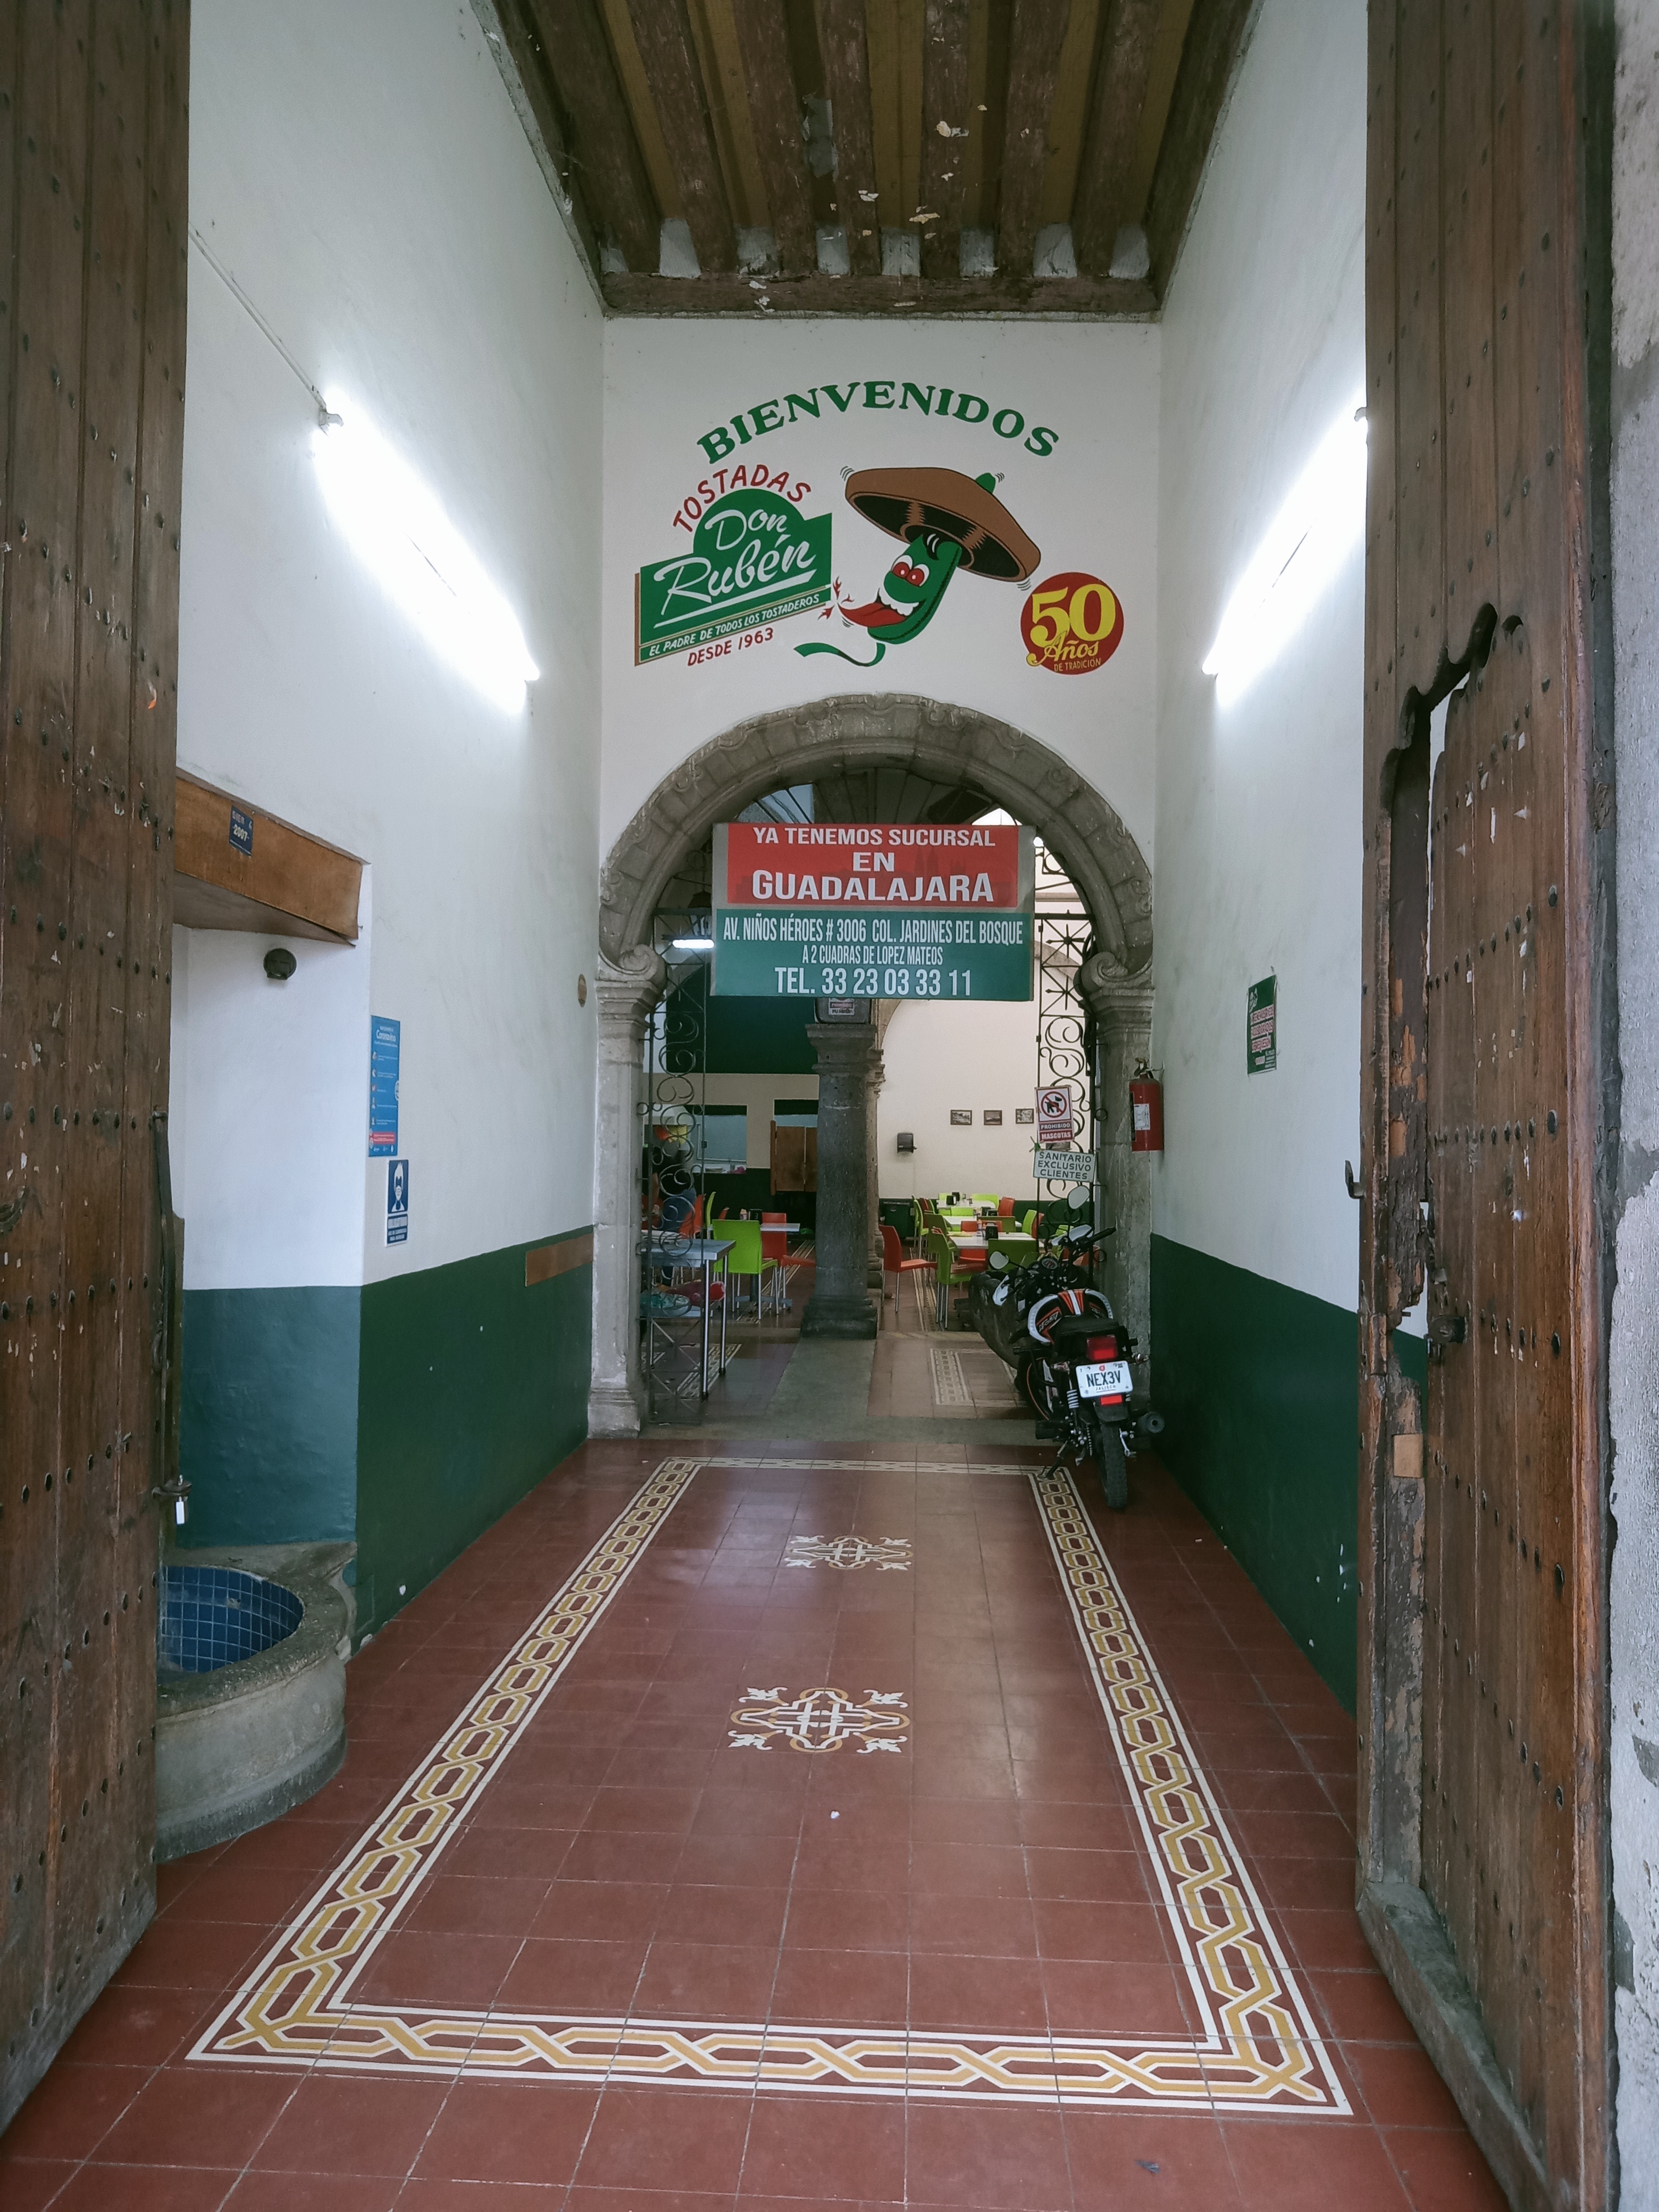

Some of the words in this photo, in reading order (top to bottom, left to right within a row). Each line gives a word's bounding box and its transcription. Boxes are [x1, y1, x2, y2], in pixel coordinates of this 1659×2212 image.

[697, 381, 1060, 464] BIENVENIDOS
[673, 464, 811, 533] TOSTADAS
[705, 508, 787, 551] Don
[654, 534, 817, 616] Rubén
[649, 646, 660, 657] EL
[663, 633, 696, 652] PADRE
[700, 629, 713, 641] DE
[715, 618, 743, 636] TODOS
[744, 613, 760, 626] LOS
[761, 593, 820, 621] TOSTADEROS
[1030, 583, 1116, 648] 50
[687, 640, 733, 667] DESDE
[738, 627, 774, 650] 1963
[1026, 630, 1100, 667] Años
[1053, 663, 1063, 672] DE
[752, 827, 778, 844] YA
[784, 827, 883, 846] TENEMOS
[888, 828, 996, 847] SUCURSAL
[852, 852, 895, 873] EN
[752, 869, 995, 902] GUADALAJARA
[723, 917, 740, 941] AV.
[743, 912, 777, 941] NIÑOS
[780, 913, 824, 942] HÉROES
[825, 918, 834, 942] #
[836, 918, 866, 942] 3006
[872, 919, 896, 943] COL.
[899, 919, 953, 944] JARDINES
[956, 920, 976, 944] DEL
[979, 920, 1023, 946] BOSQUE
[802, 944, 809, 963] A
[811, 944, 817, 963] 2
[819, 945, 861, 964] CUADRAS
[863, 945, 875, 965] DE
[877, 945, 905, 965] LOPEZ
[907, 946, 943, 966] MATEOS
[774, 967, 816, 994] TEL.
[822, 967, 847, 995] 33
[853, 968, 878, 995] 23
[884, 968, 910, 996] 03
[915, 968, 941, 996] 33
[948, 969, 971, 996] 11
[1037, 1160, 1091, 1171] EXCLUSIVO
[1039, 1152, 1092, 1163] SANITARIO
[1040, 1169, 1087, 1179] CLIENTES
[1086, 1370, 1120, 1387] NEX3V
